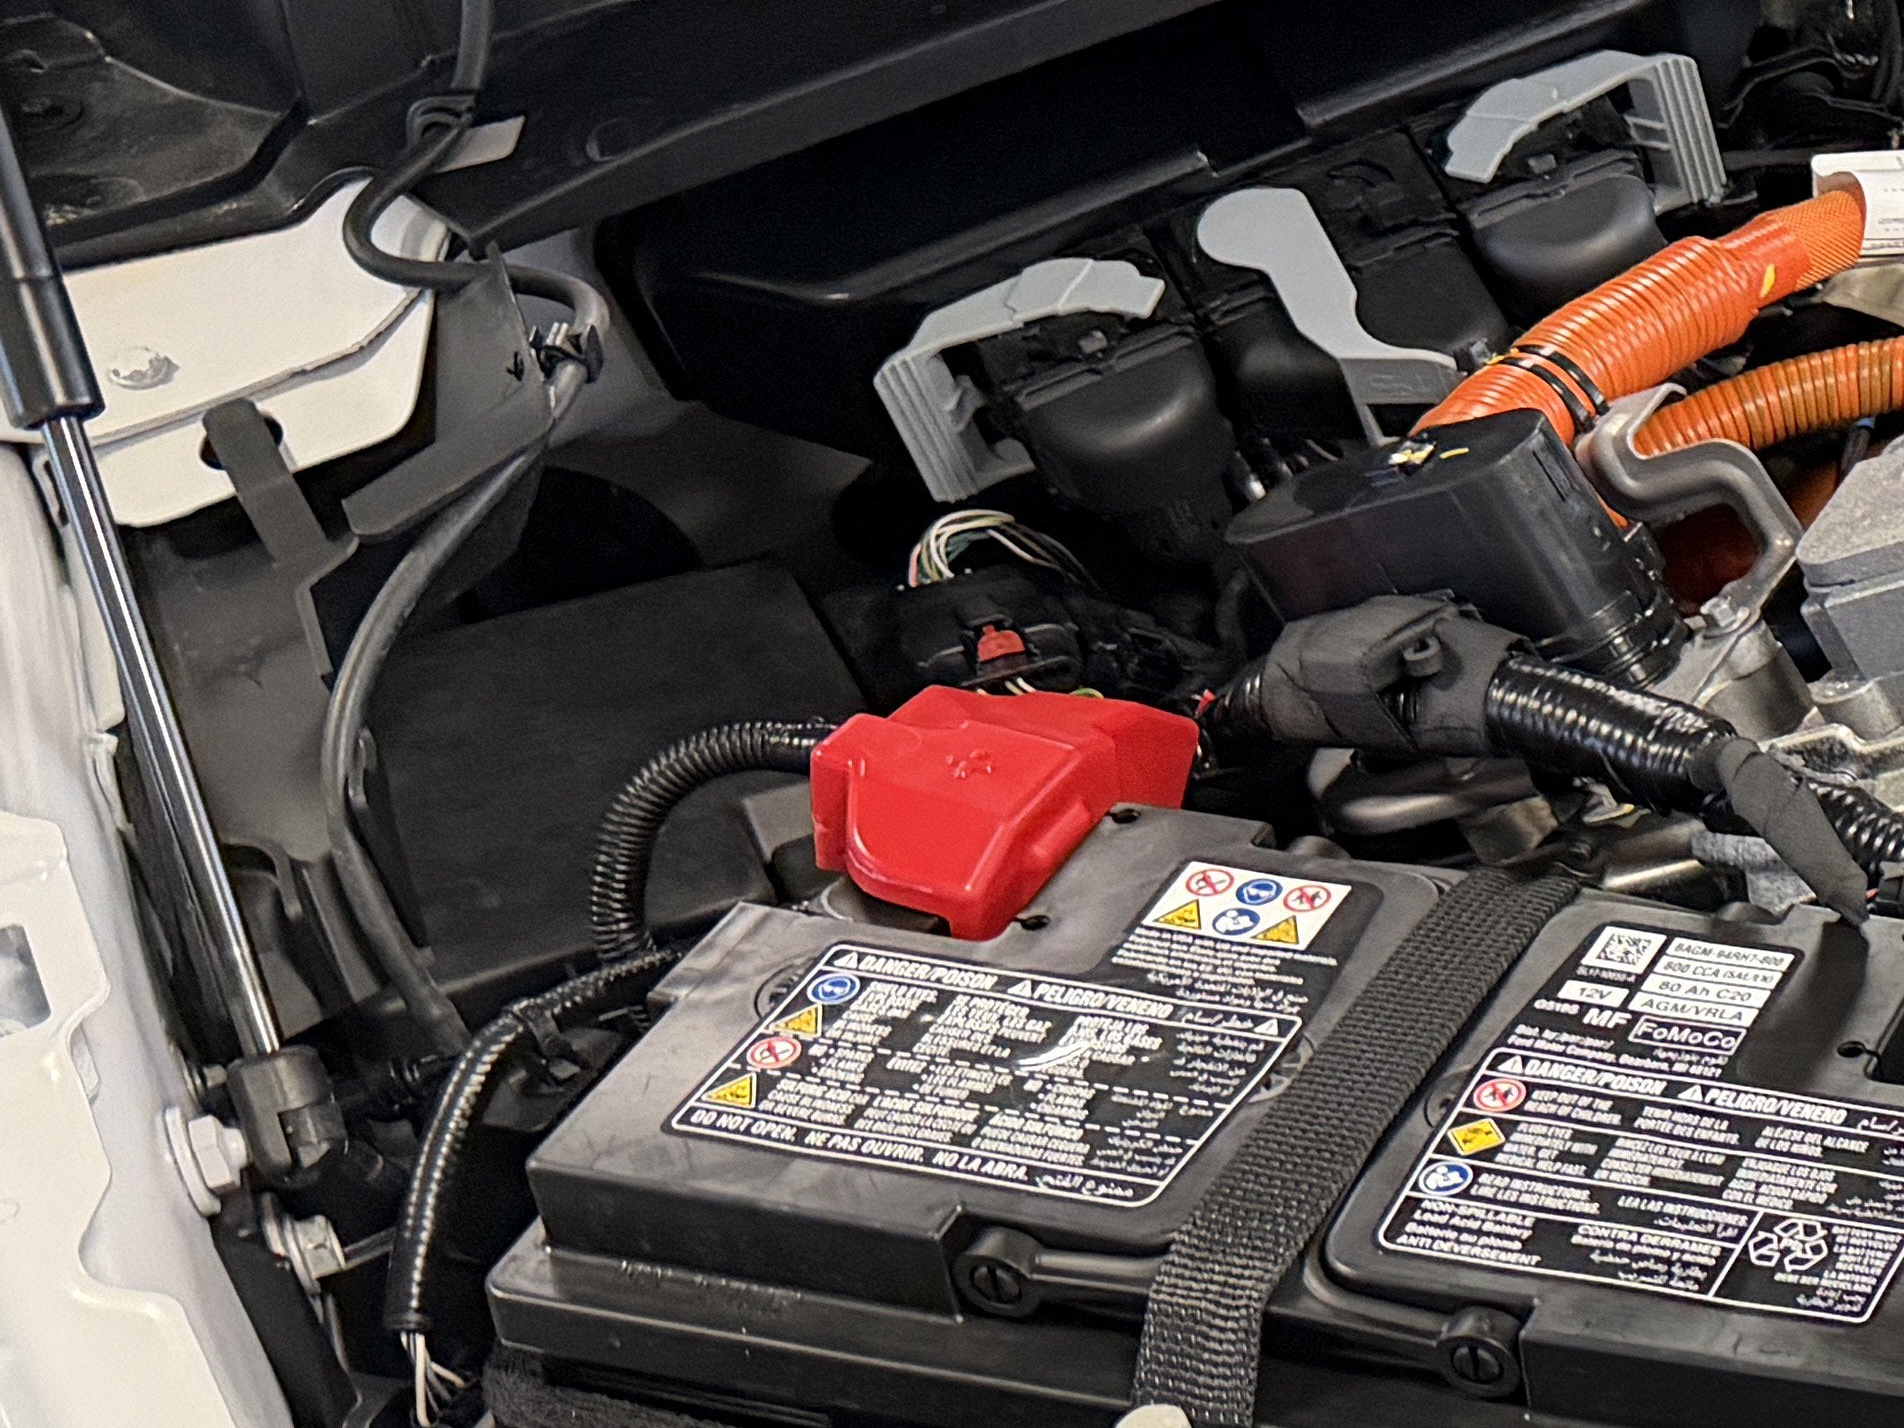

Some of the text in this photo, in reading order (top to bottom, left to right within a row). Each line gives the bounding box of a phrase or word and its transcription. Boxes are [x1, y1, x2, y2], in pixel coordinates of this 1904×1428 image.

[855, 954, 1001, 990] DANGER/POISON
[1694, 965, 1721, 978] CCA
[1028, 982, 1178, 1019] PELIGRO/VENENO
[1579, 986, 1613, 1001] 12V
[1659, 981, 1752, 1002] 80 Ah C20
[1583, 1007, 1632, 1030] MF
[1641, 997, 1744, 1022] AGM/VRLA
[1508, 1035, 1535, 1050] Ford
[1536, 1039, 1566, 1054] Motor
[1637, 1021, 1738, 1050] FoMoCo
[1521, 1057, 1669, 1096] DANGER/POISON
[1702, 1086, 1850, 1125] PELIGRO/VENENO
[685, 1108, 1038, 1181] DO NOT OPEN. NE PAS OUVRIR. NO LA ABRA.
[1418, 1199, 1538, 1227] NON-SPILLABLE
[1615, 1195, 1642, 1209] LEA
[1637, 1198, 1665, 1212] LAS
[1411, 1209, 1451, 1224] Lead
[1478, 1221, 1535, 1240] Battery
[1393, 1233, 1434, 1248] ANTI
[1575, 1223, 1725, 1257] CONTRA DERRAMES
